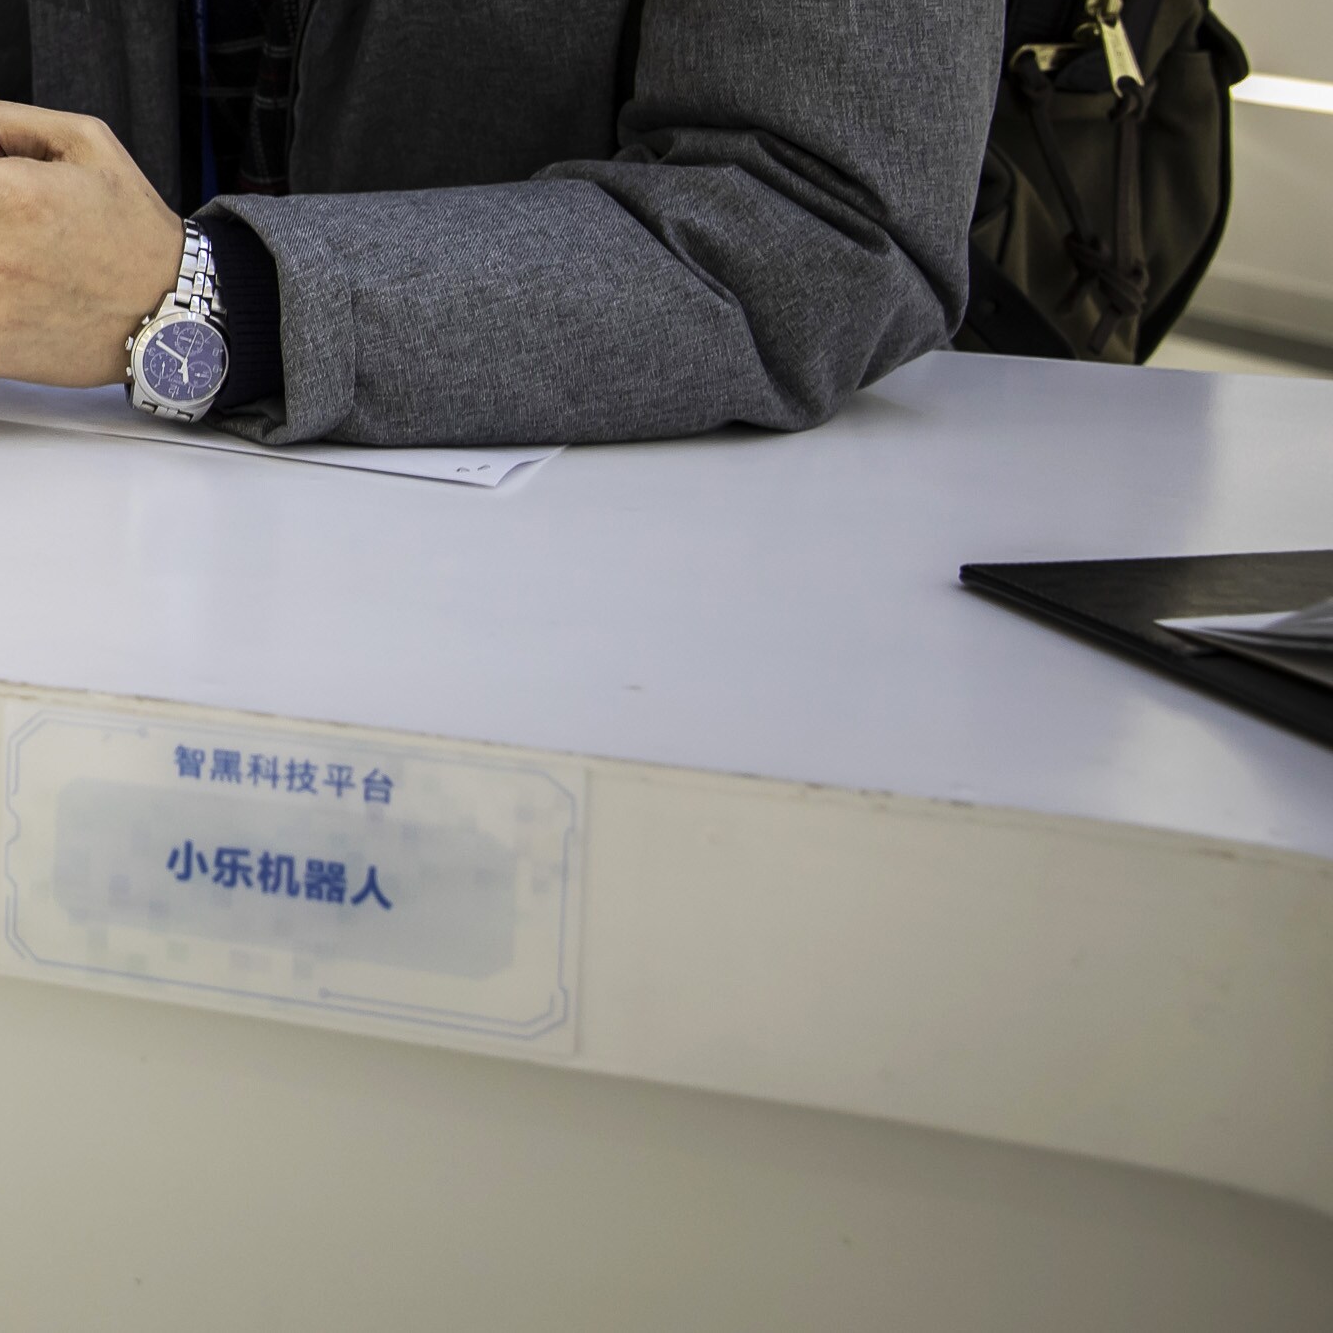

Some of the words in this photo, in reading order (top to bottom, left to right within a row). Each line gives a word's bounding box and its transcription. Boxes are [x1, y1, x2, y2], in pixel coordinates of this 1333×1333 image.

[174, 744, 394, 804] 智黑科技平台
[166, 839, 392, 910] 小乐机器人
